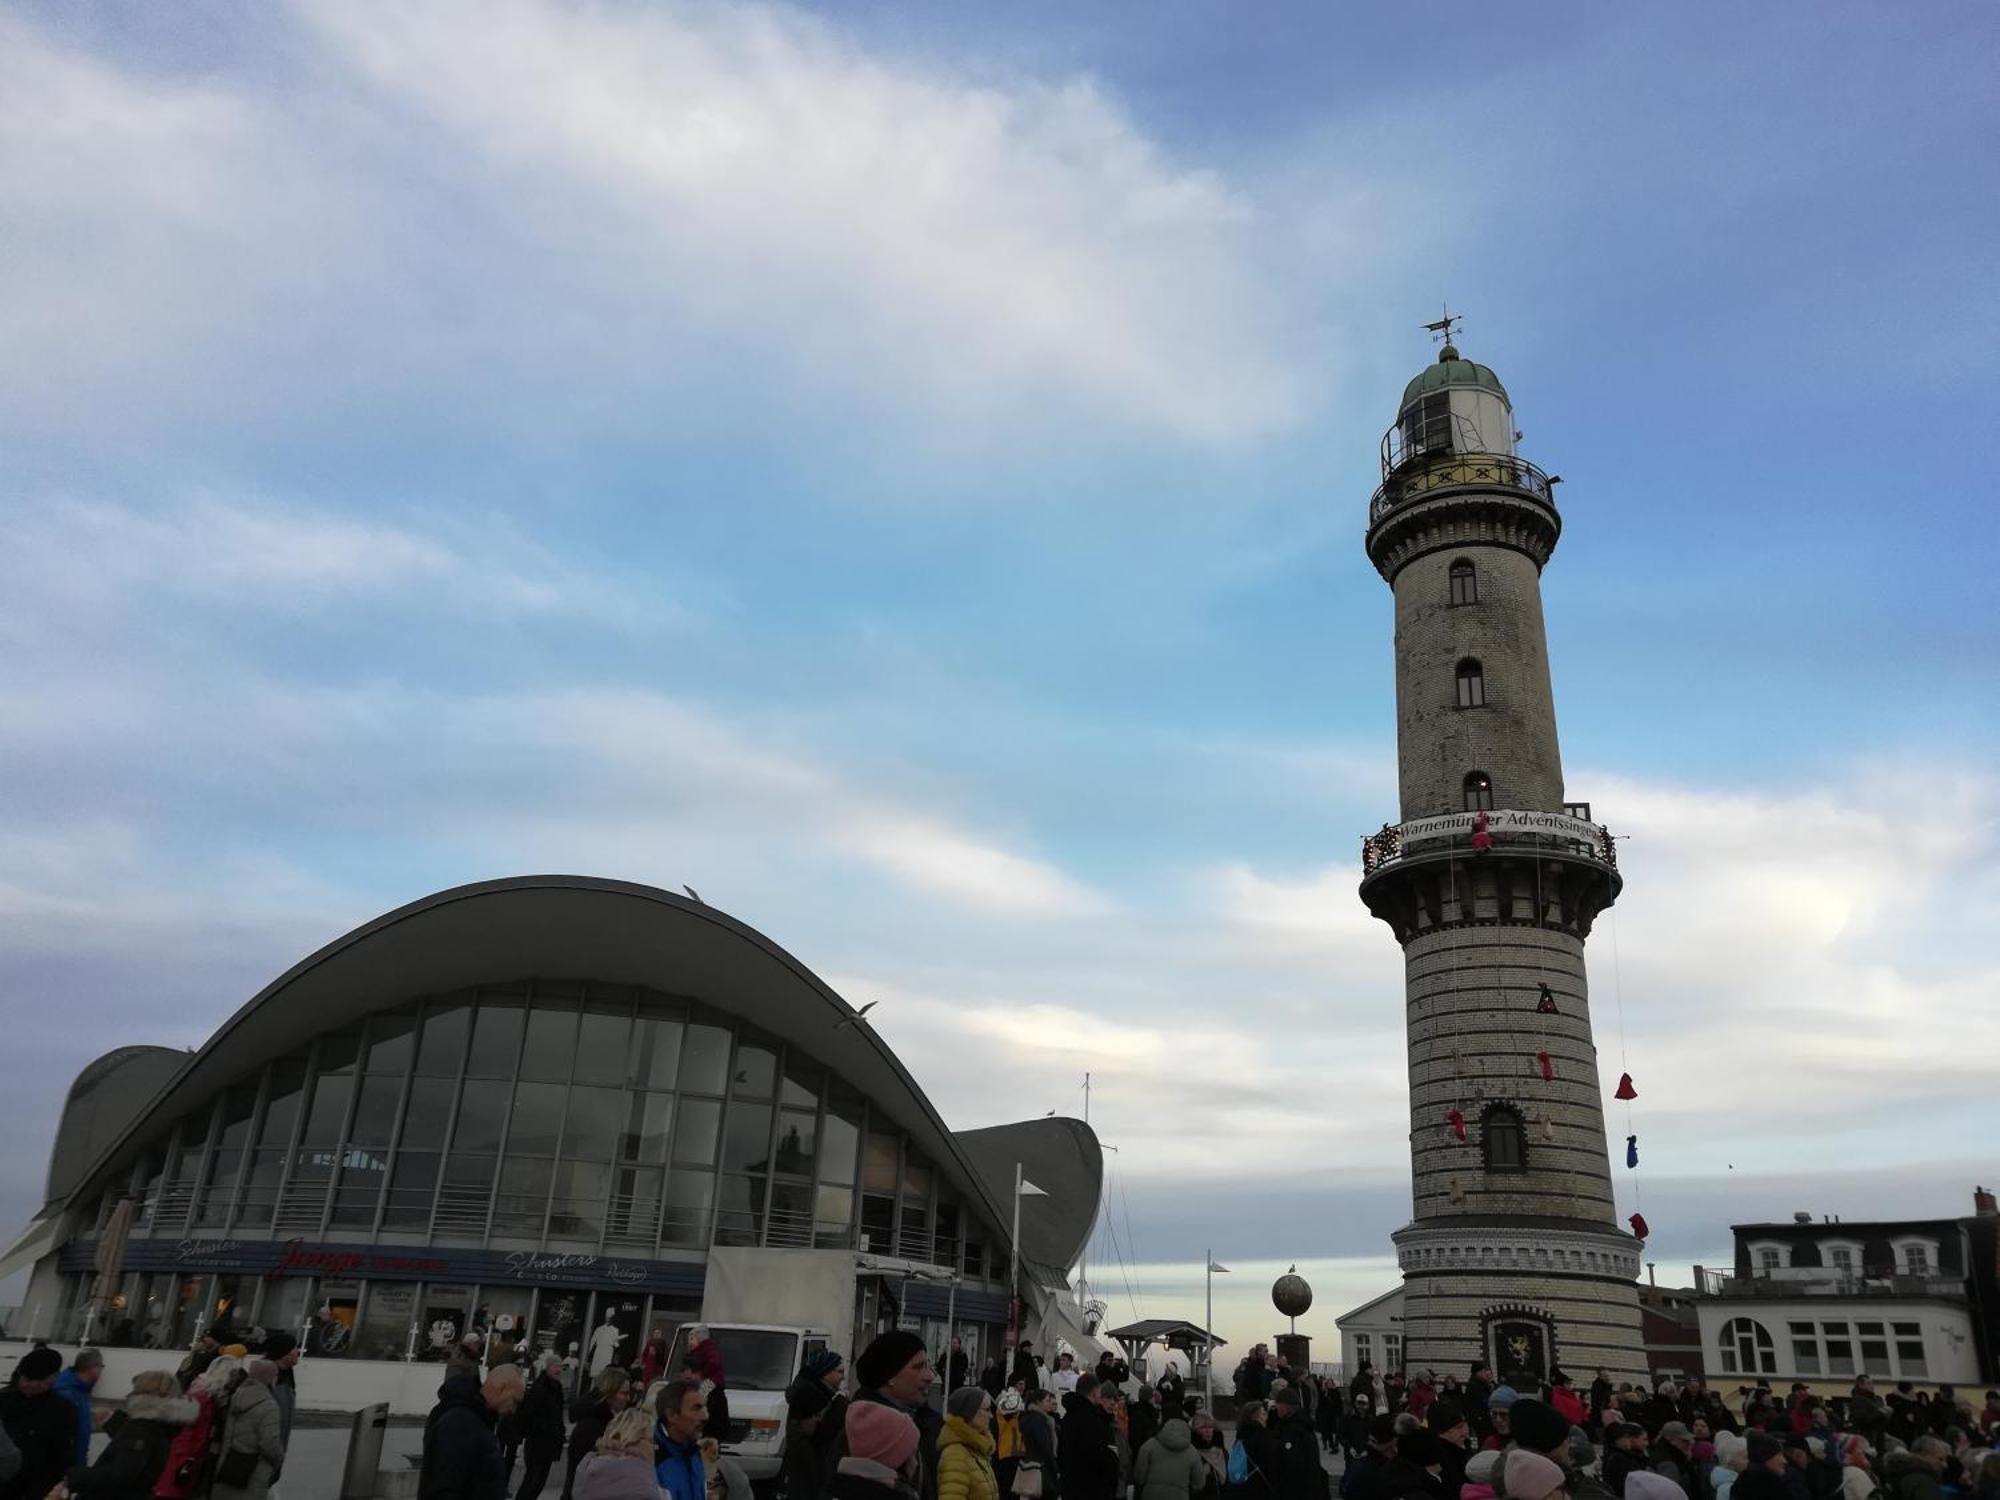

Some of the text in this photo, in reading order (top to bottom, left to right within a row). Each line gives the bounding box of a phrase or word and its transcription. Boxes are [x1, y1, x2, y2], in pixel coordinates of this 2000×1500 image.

[1401, 812, 1597, 838] Warnemüner Adventssingen
[504, 1250, 598, 1272] Schusters
